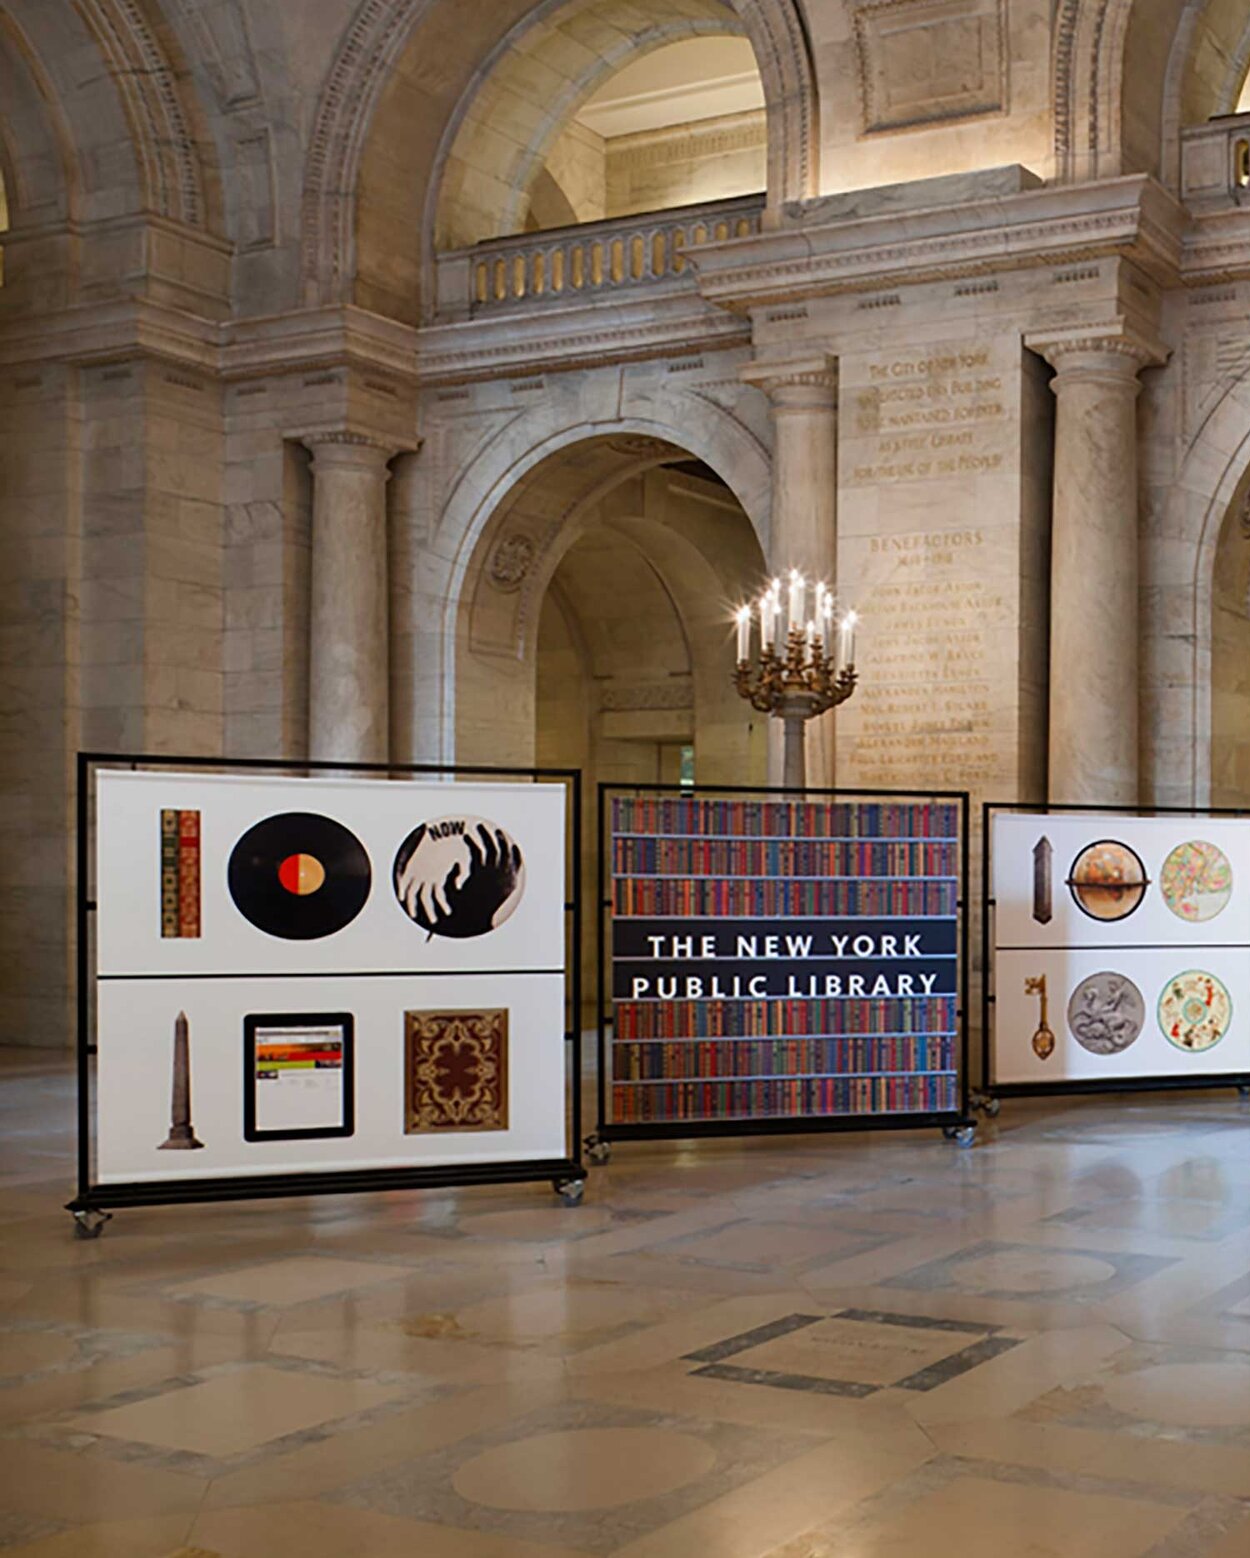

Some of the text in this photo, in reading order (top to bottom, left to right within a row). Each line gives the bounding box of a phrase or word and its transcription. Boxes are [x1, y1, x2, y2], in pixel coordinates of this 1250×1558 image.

[870, 530, 984, 553] BENEFACTORS
[428, 821, 466, 841] NOW
[648, 934, 922, 958] THE NEW YORK
[632, 973, 937, 999] PUBLIC LIBRARY
